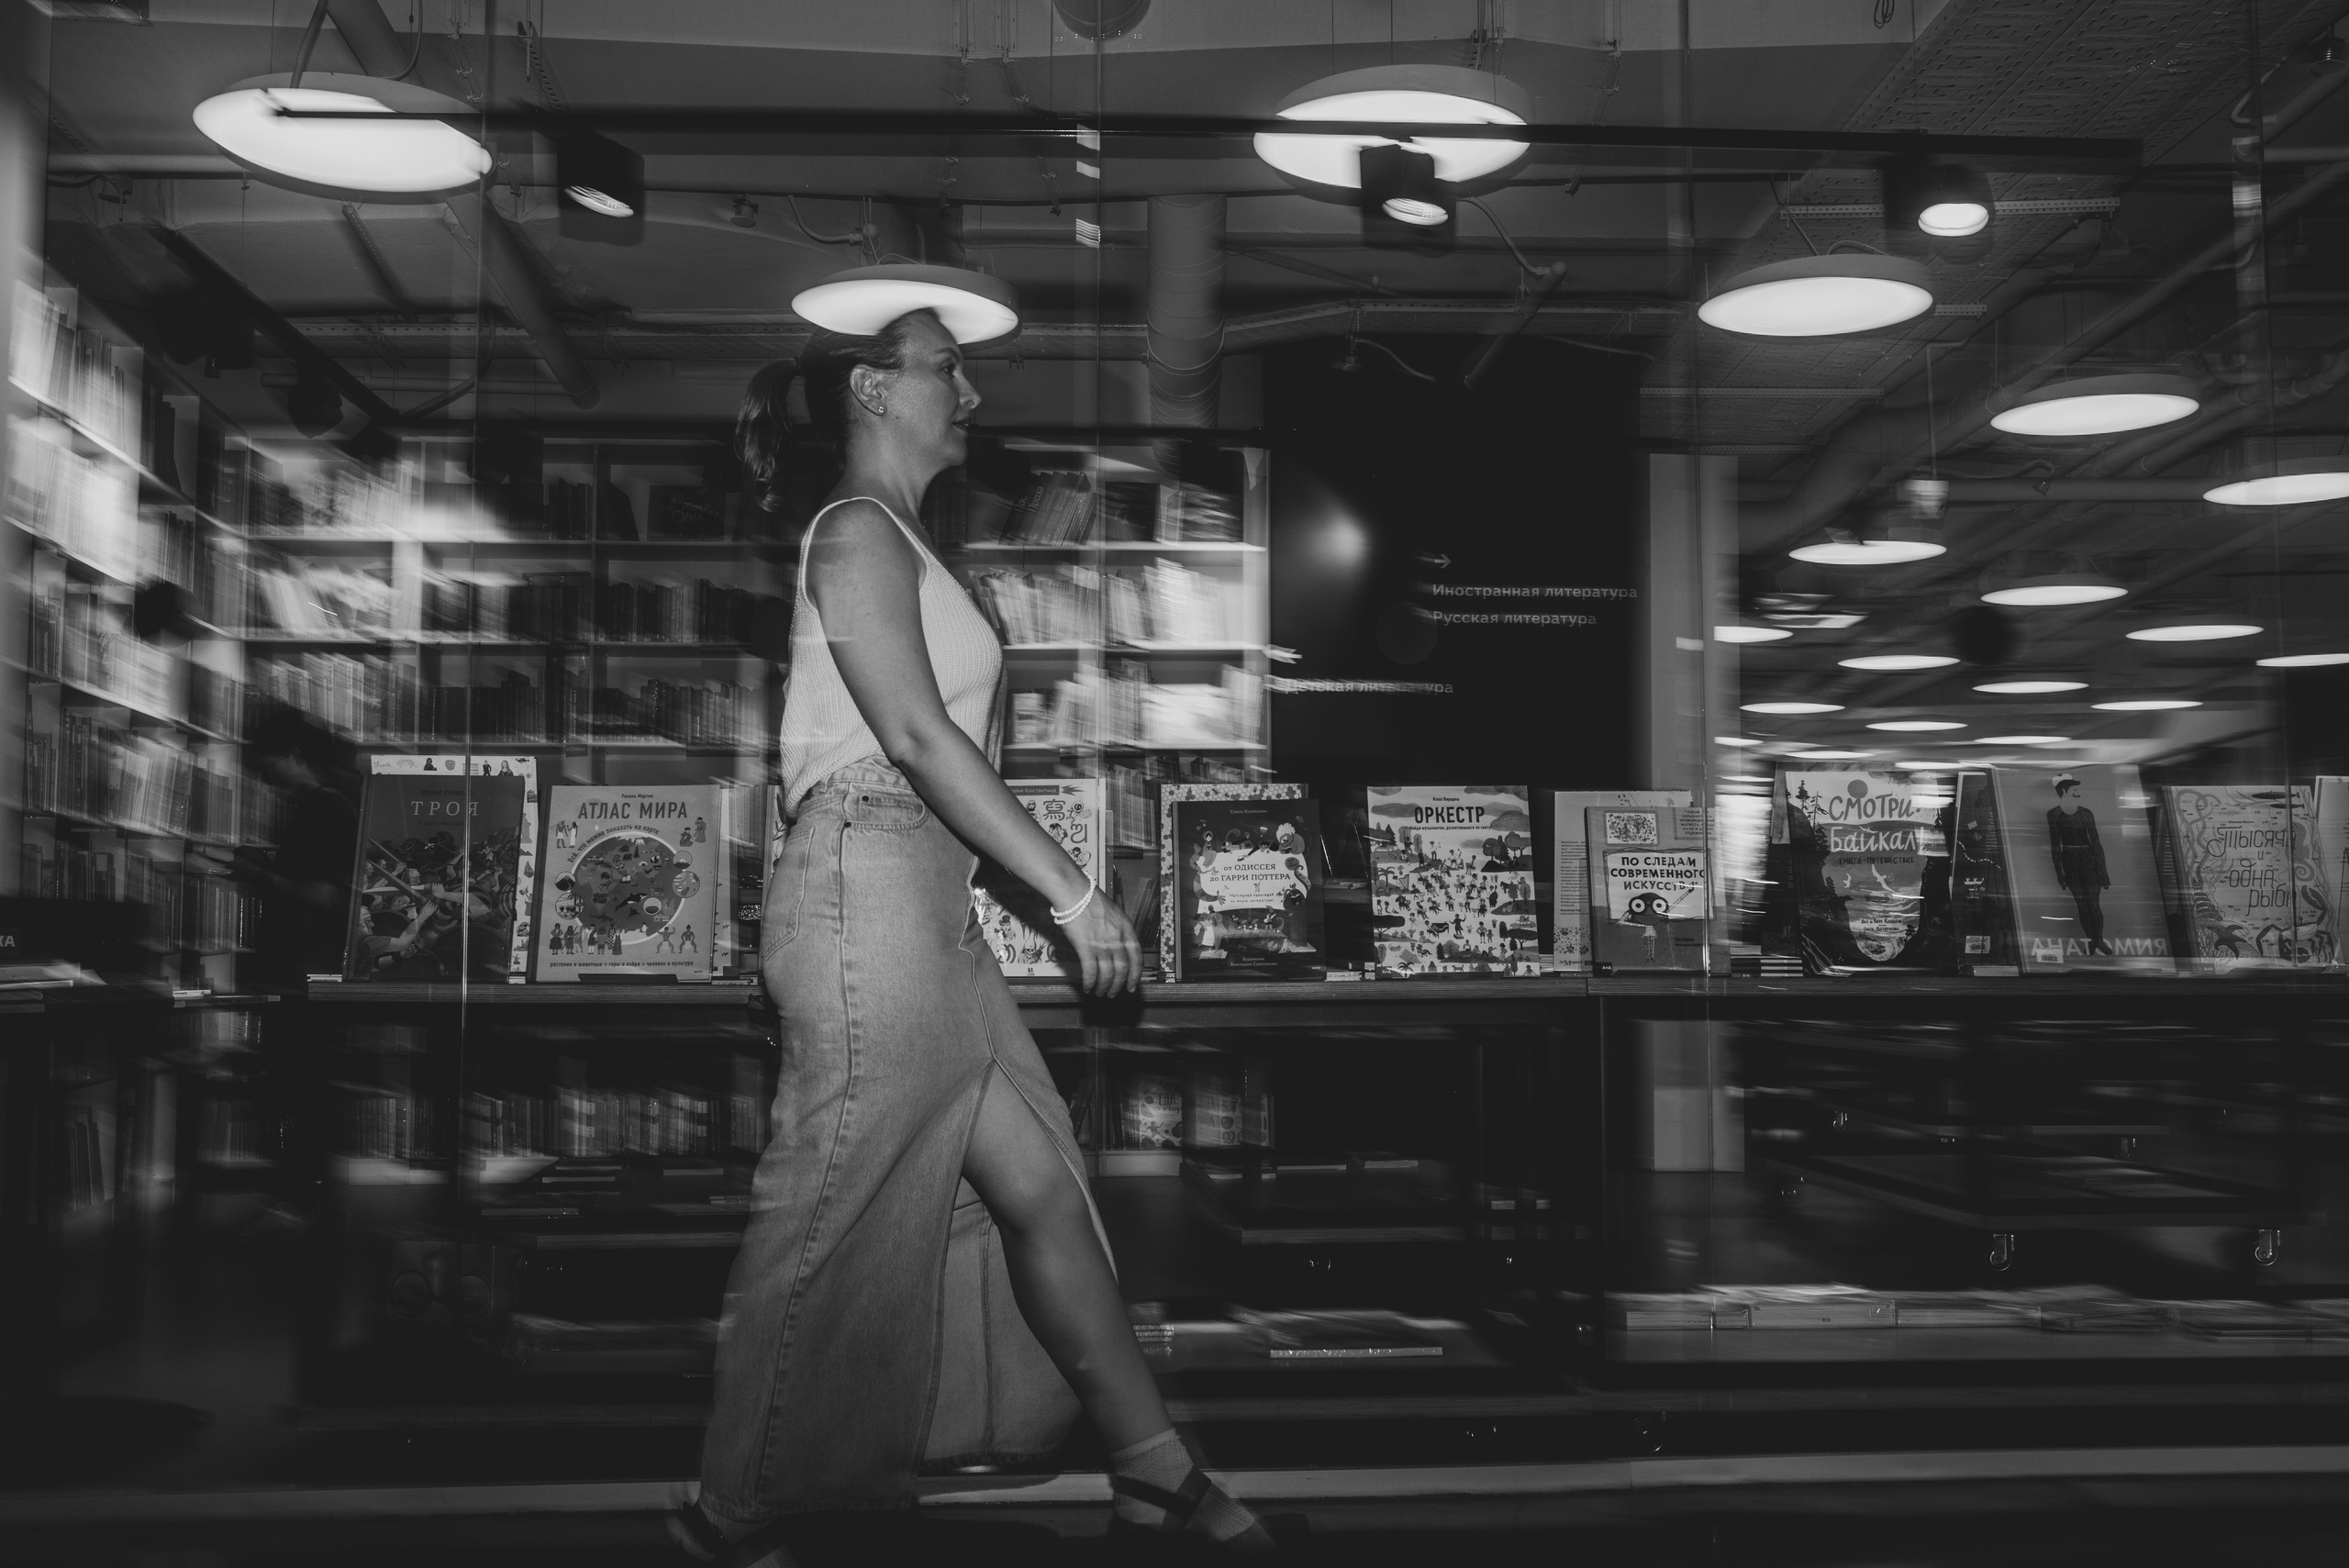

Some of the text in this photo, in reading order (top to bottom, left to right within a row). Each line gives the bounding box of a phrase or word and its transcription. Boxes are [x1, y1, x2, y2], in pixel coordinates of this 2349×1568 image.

[1027, 485, 1044, 513] Проза
[1432, 584, 1638, 601] Иностранная литература
[1433, 611, 1598, 628] Русская литература
[410, 801, 479, 817] ТРОЯ
[578, 802, 688, 819] АТЛАС МИРА
[1414, 806, 1485, 824] ОРКЕСТР
[577, 843, 587, 851] что
[586, 830, 606, 845] можно
[606, 825, 633, 834] показать
[642, 826, 660, 835] карте
[1831, 826, 1924, 853] Байкал!
[1621, 856, 1696, 867] ПО СЛЕДАМ
[2257, 851, 2265, 861] и
[1234, 863, 1276, 872] ОДИССЕЯ
[1251, 873, 1291, 881] ПОТТЕРА
[2245, 883, 2291, 917] рыб
[1158, 1094, 1179, 1106] ЕДА:
